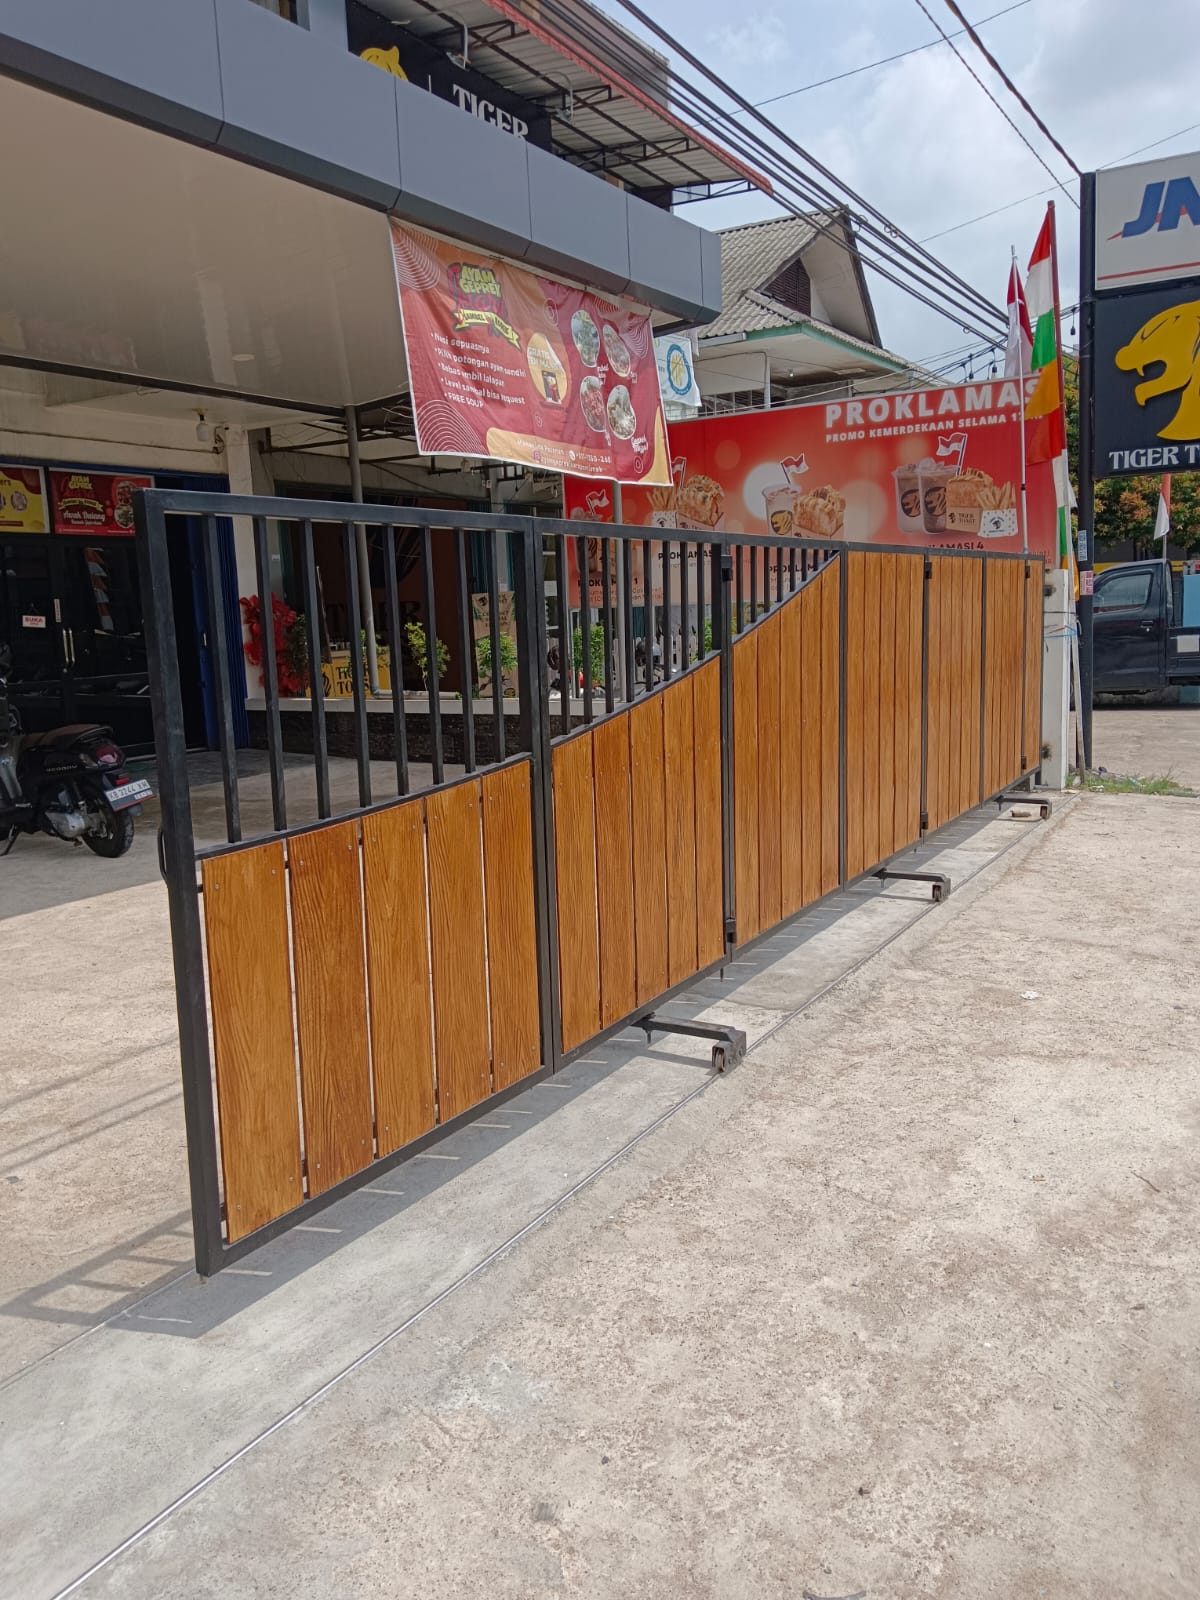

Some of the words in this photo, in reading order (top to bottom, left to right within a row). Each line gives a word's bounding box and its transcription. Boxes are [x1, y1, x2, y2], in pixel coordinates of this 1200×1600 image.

[462, 266, 496, 283] AYAM
[451, 339, 490, 354] sepuasnya
[437, 347, 452, 359] Pilih
[453, 354, 489, 368] potongan
[490, 363, 504, 373] ayam
[441, 362, 461, 375] Bebas
[445, 377, 461, 389] Level
[462, 384, 485, 397] sambal
[486, 388, 500, 400] bisa
[501, 394, 525, 406] request
[448, 391, 466, 404] FREE
[466, 396, 484, 408] SOUP
[826, 429, 865, 444] PROMO
[869, 419, 954, 438] KEMERDEKAAN
[958, 413, 1007, 428] SELAMA
[1109, 446, 1179, 469] TIGER
